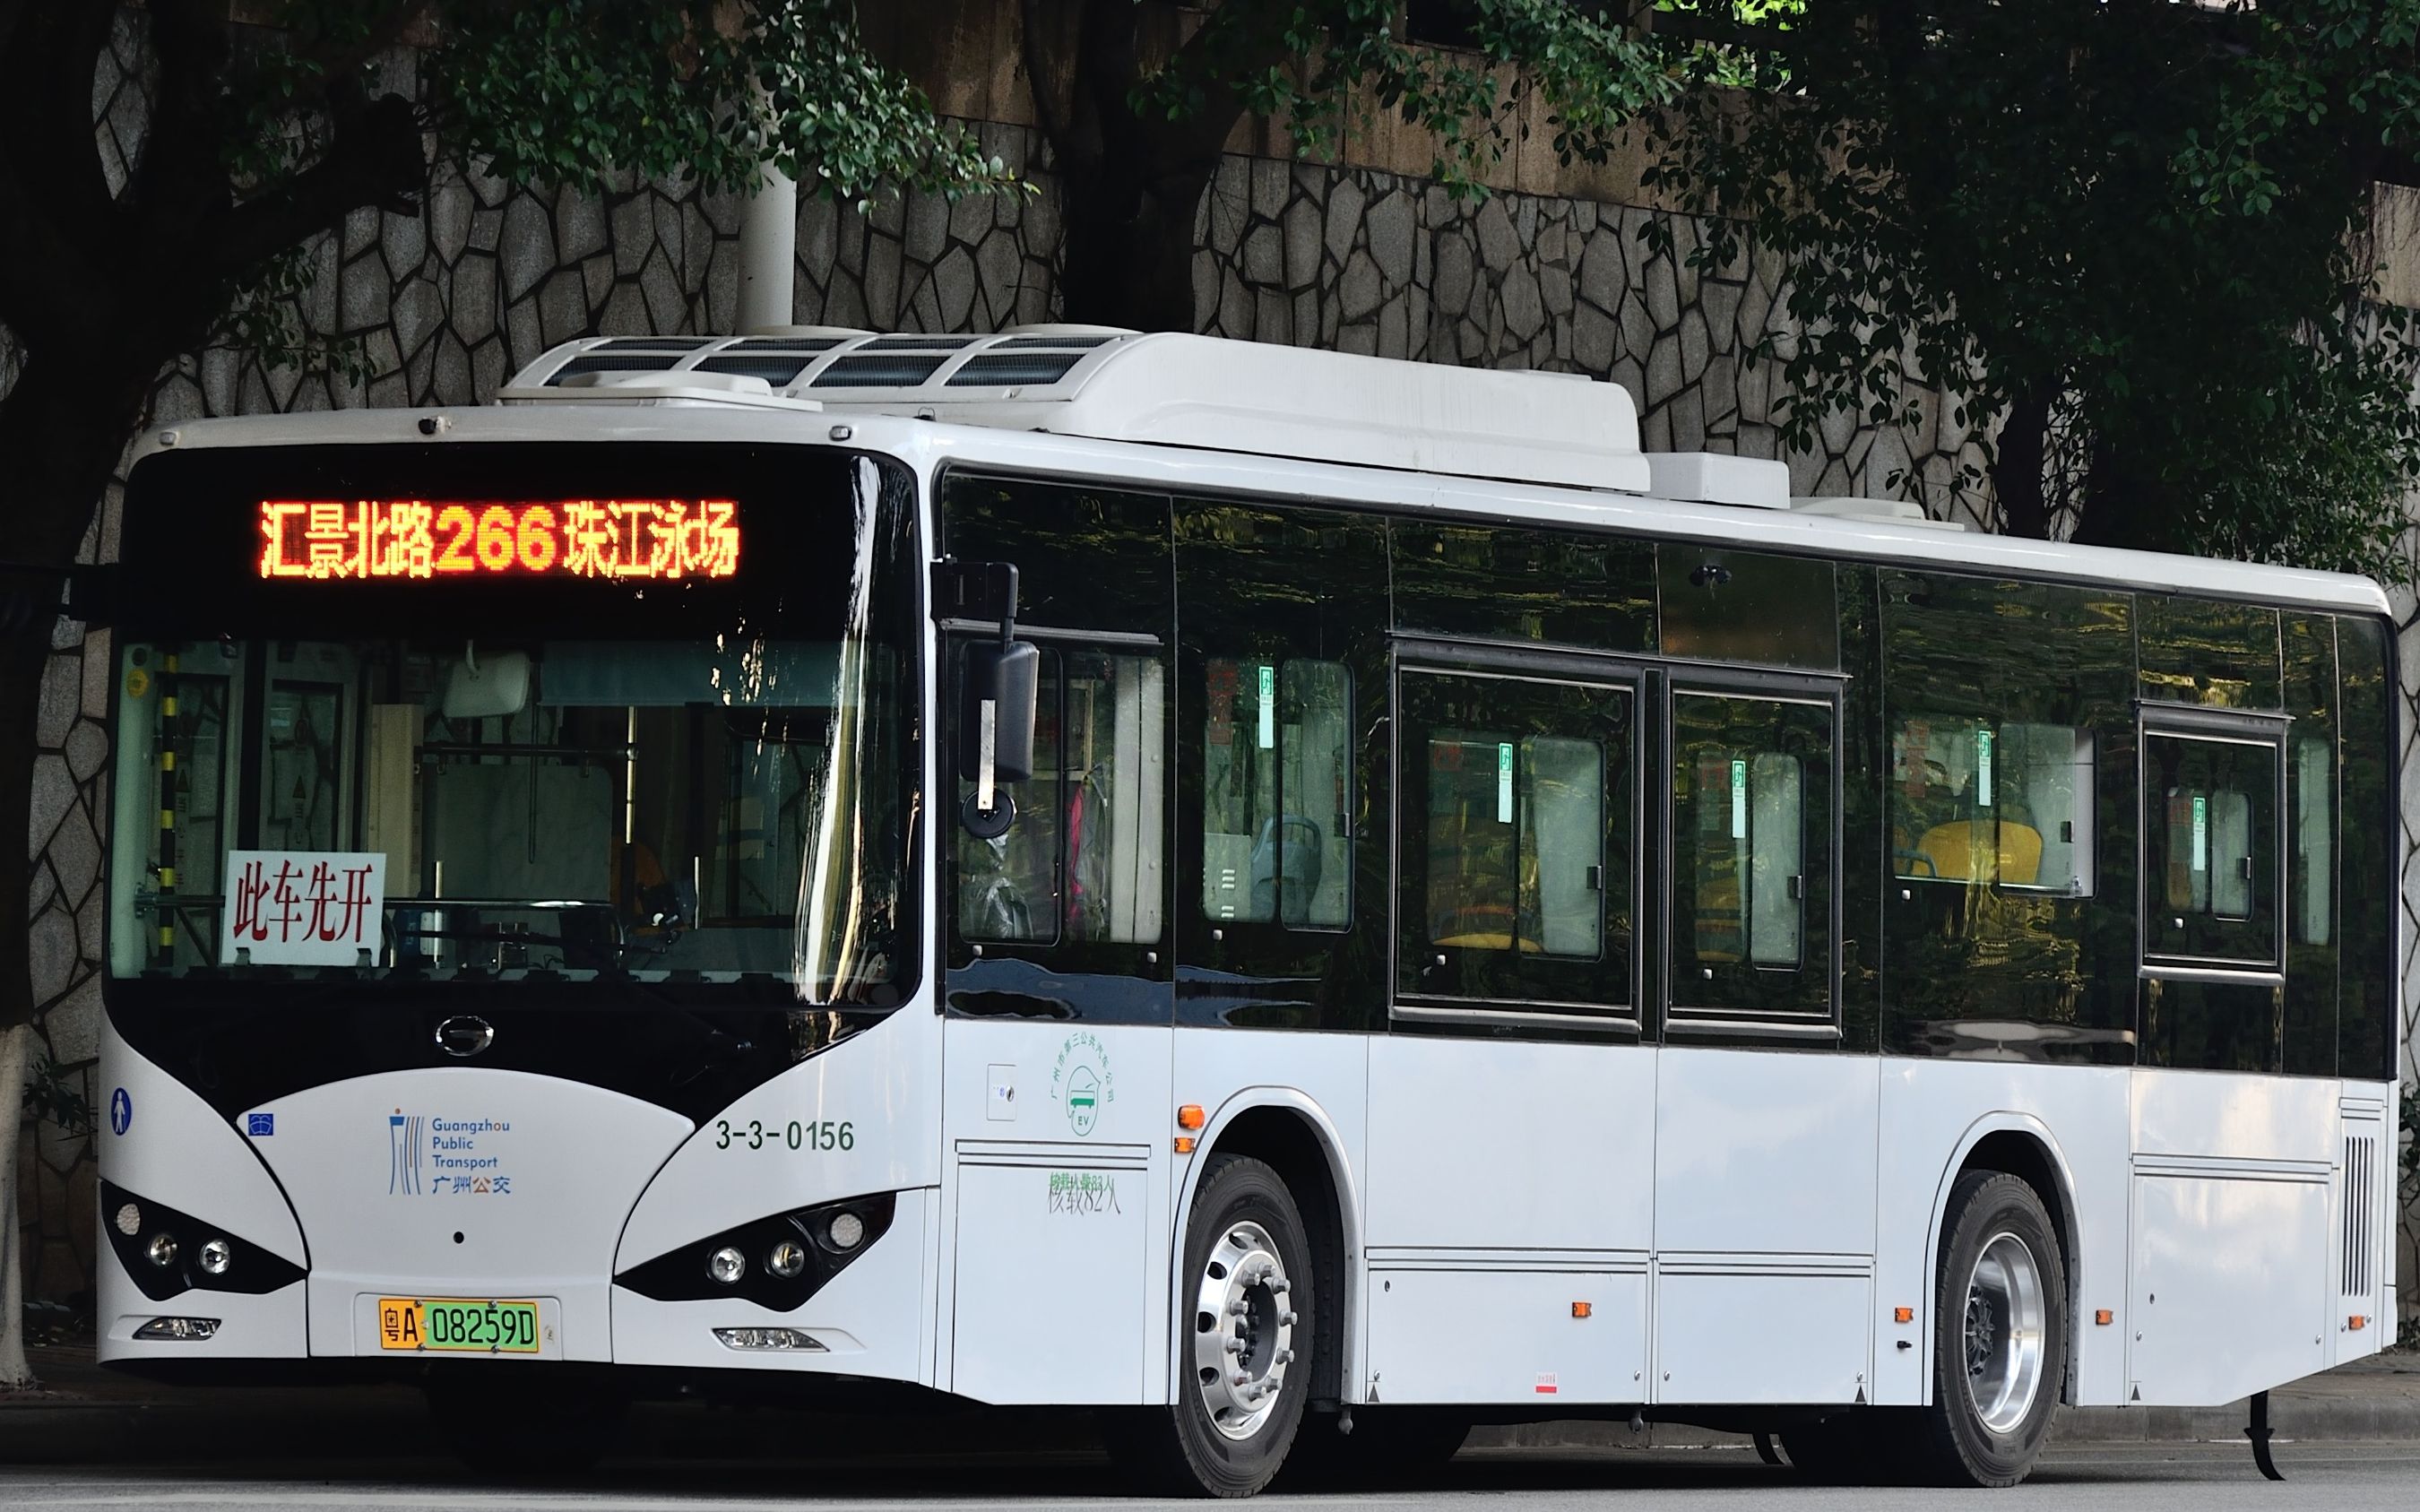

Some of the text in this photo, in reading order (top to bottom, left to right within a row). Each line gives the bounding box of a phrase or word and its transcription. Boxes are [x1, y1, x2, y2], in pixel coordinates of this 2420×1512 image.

[261, 500, 739, 578] 汇景北路 266 珠江泳场
[233, 859, 374, 944] 此车先开
[432, 1118, 510, 1135] Guangzhou
[1077, 1115, 1090, 1127] EV
[432, 1136, 474, 1150] Public
[716, 1119, 855, 1152] 3-3-0156
[432, 1154, 498, 1171] Transport
[432, 1175, 512, 1195] 广州公交
